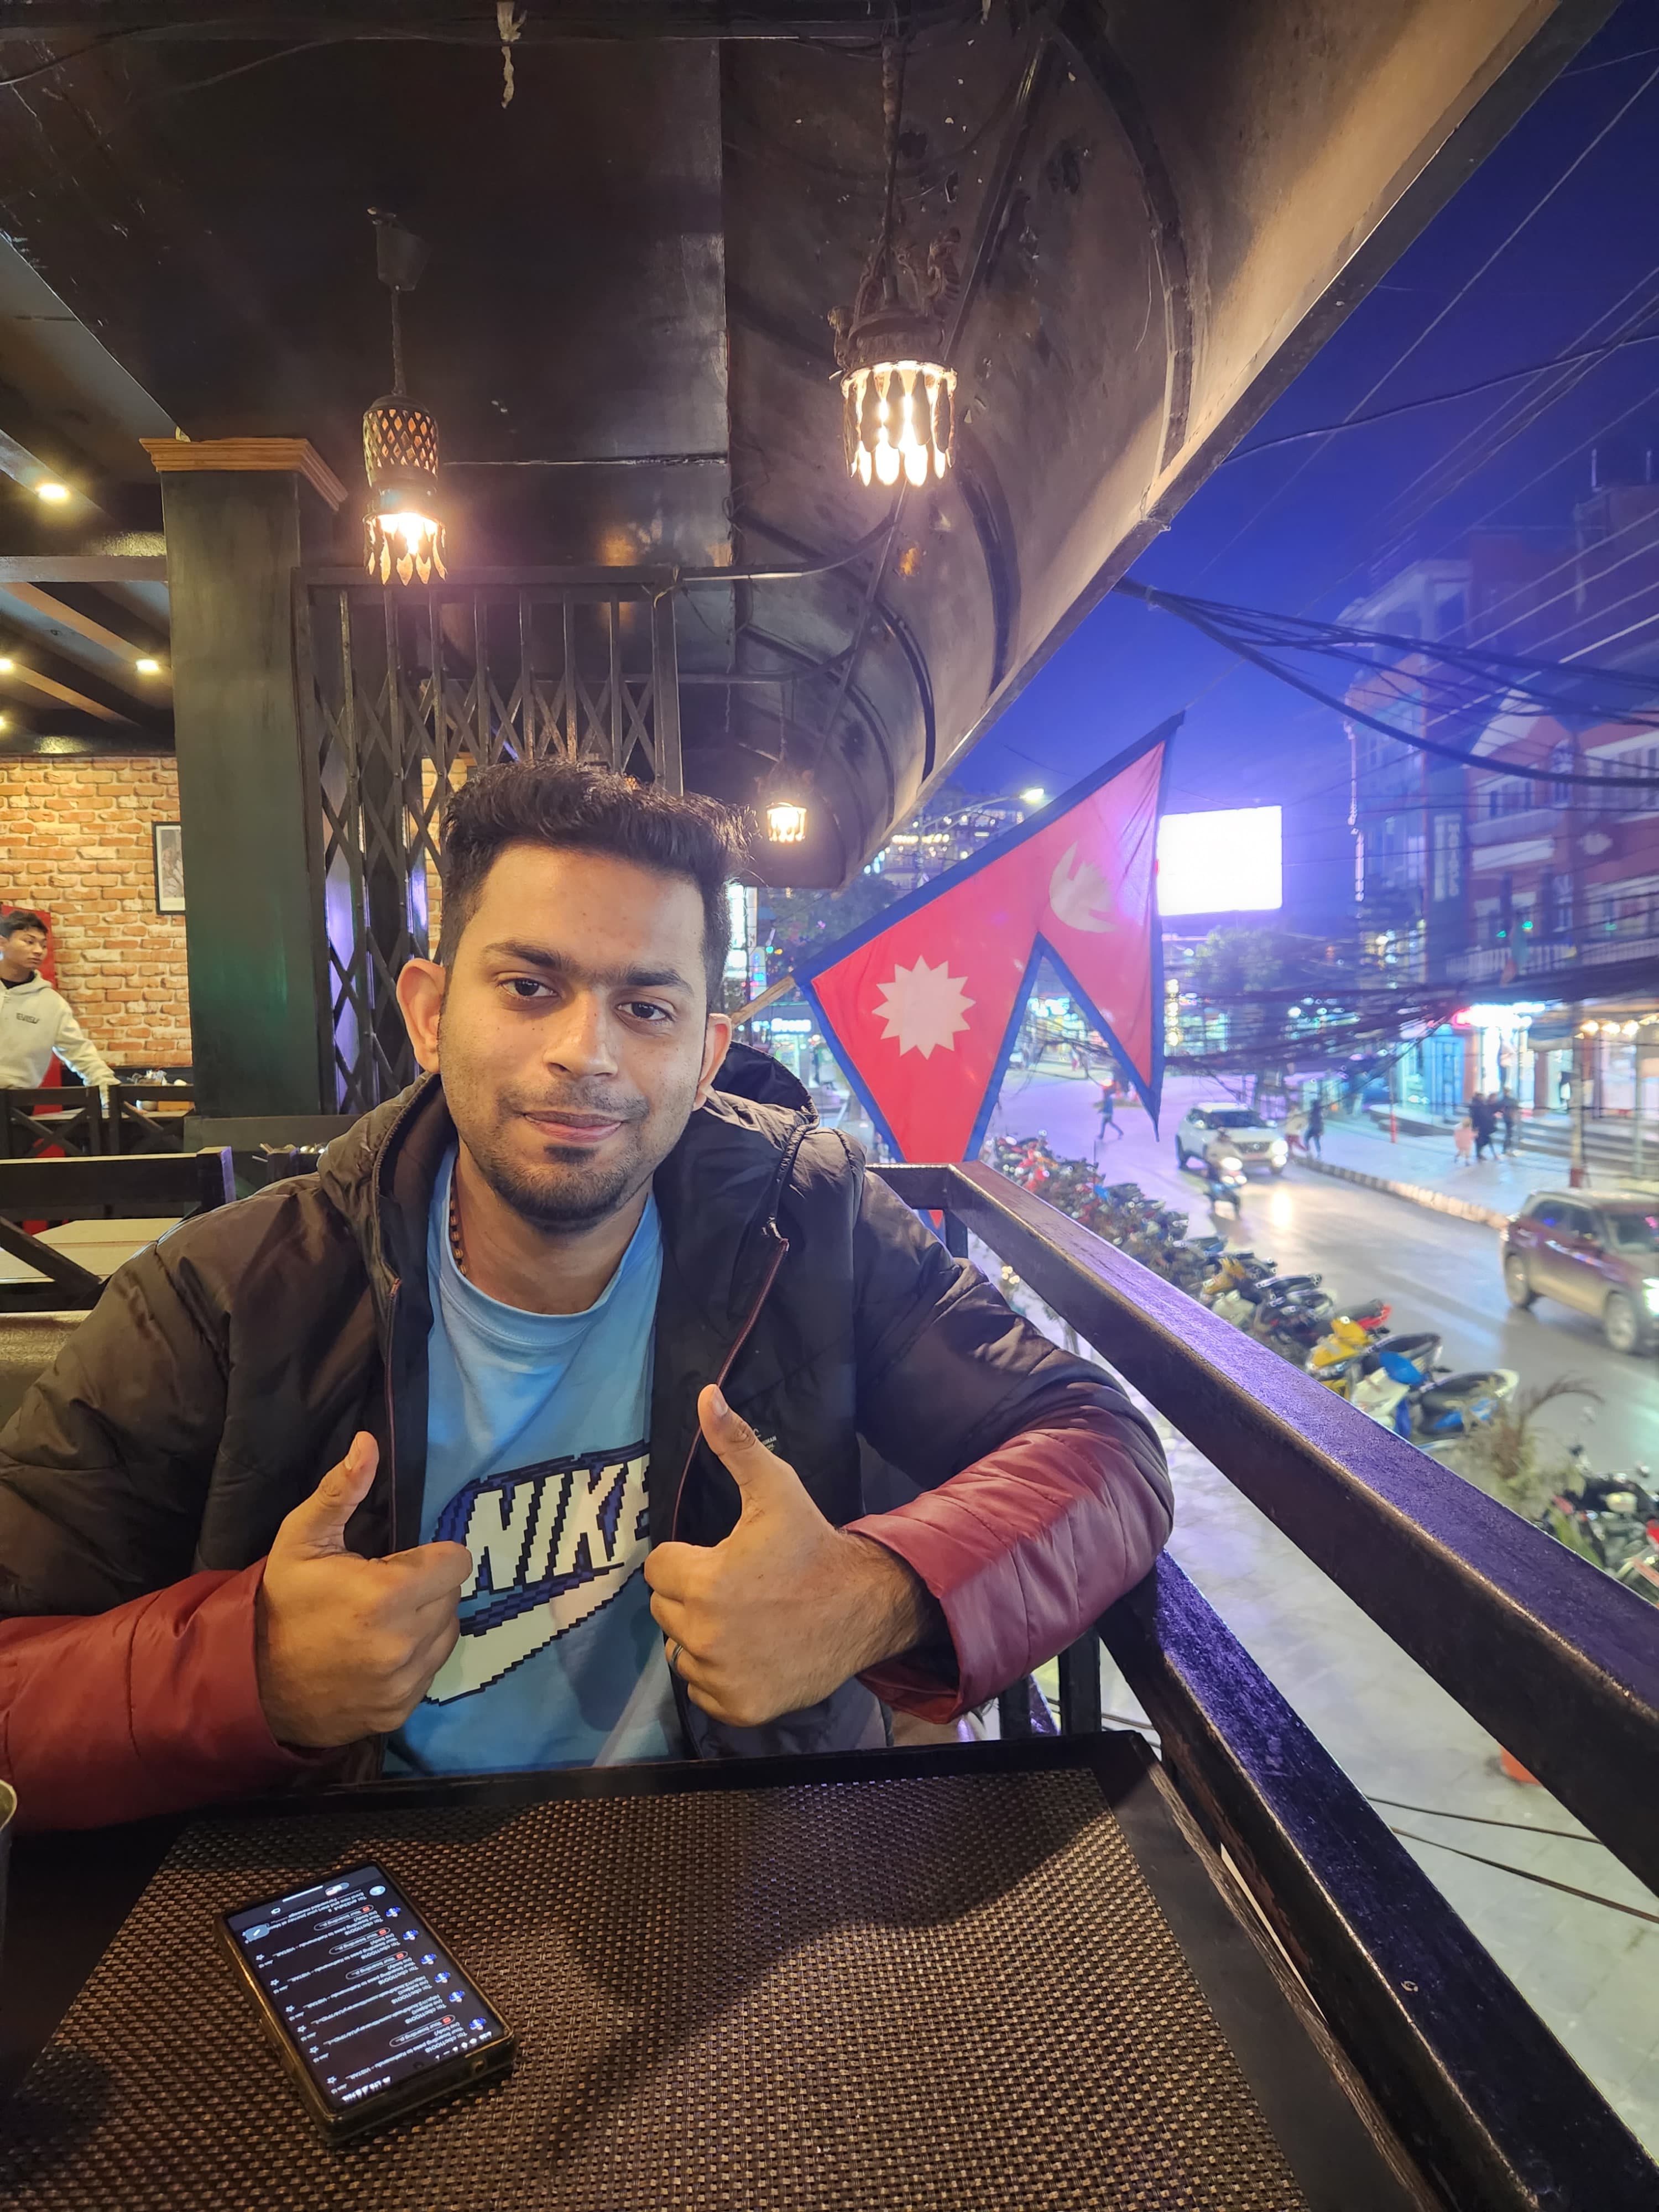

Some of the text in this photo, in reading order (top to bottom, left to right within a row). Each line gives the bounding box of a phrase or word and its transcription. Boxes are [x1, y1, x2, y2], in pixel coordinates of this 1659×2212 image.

[327, 1914, 350, 1924] boarding
[346, 1918, 369, 1929] boarding
[343, 1937, 366, 1948] boarding
[362, 1942, 385, 1953] boarding
[359, 1961, 383, 1973] boarding
[379, 1966, 404, 1978] boarding
[404, 2025, 429, 2039] boarding
[426, 2031, 451, 2045] boarding
